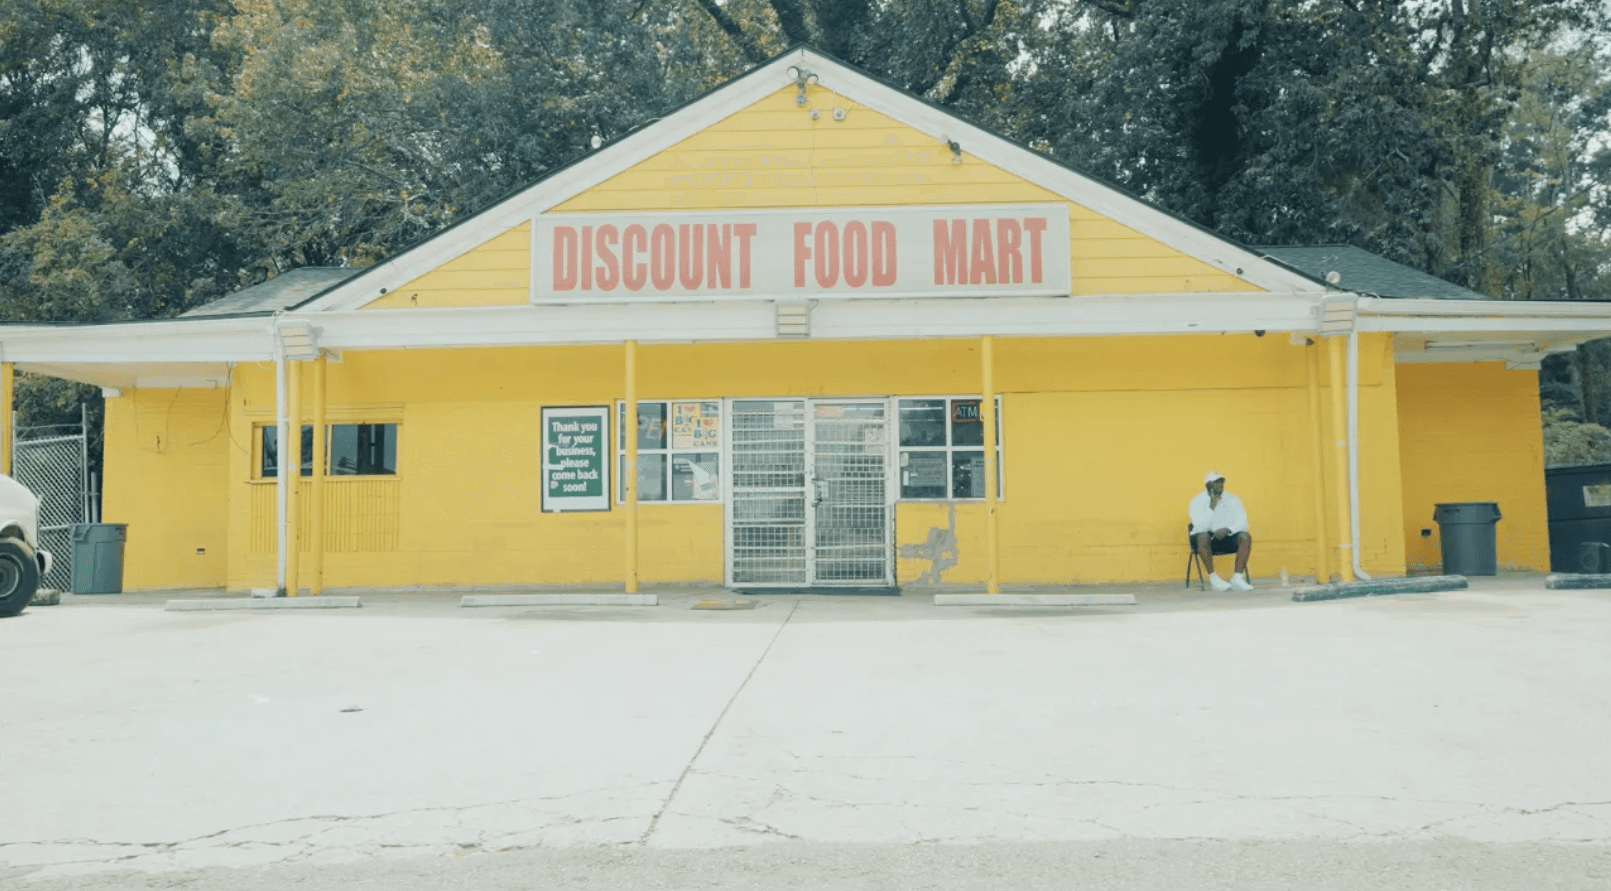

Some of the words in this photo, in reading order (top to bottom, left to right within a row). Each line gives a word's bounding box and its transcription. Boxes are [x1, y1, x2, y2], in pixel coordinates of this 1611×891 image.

[552, 223, 758, 291] DISCOUNT
[793, 220, 898, 288] FOOD
[932, 217, 1048, 285] MART
[955, 406, 978, 418] ATM
[552, 421, 580, 432] Thank
[581, 422, 598, 434] you
[558, 433, 572, 444] for
[573, 435, 595, 447] your
[556, 445, 597, 457] business,
[560, 457, 590, 469] please
[552, 471, 576, 480] come
[577, 468, 599, 480] back
[562, 481, 587, 492] soon!
